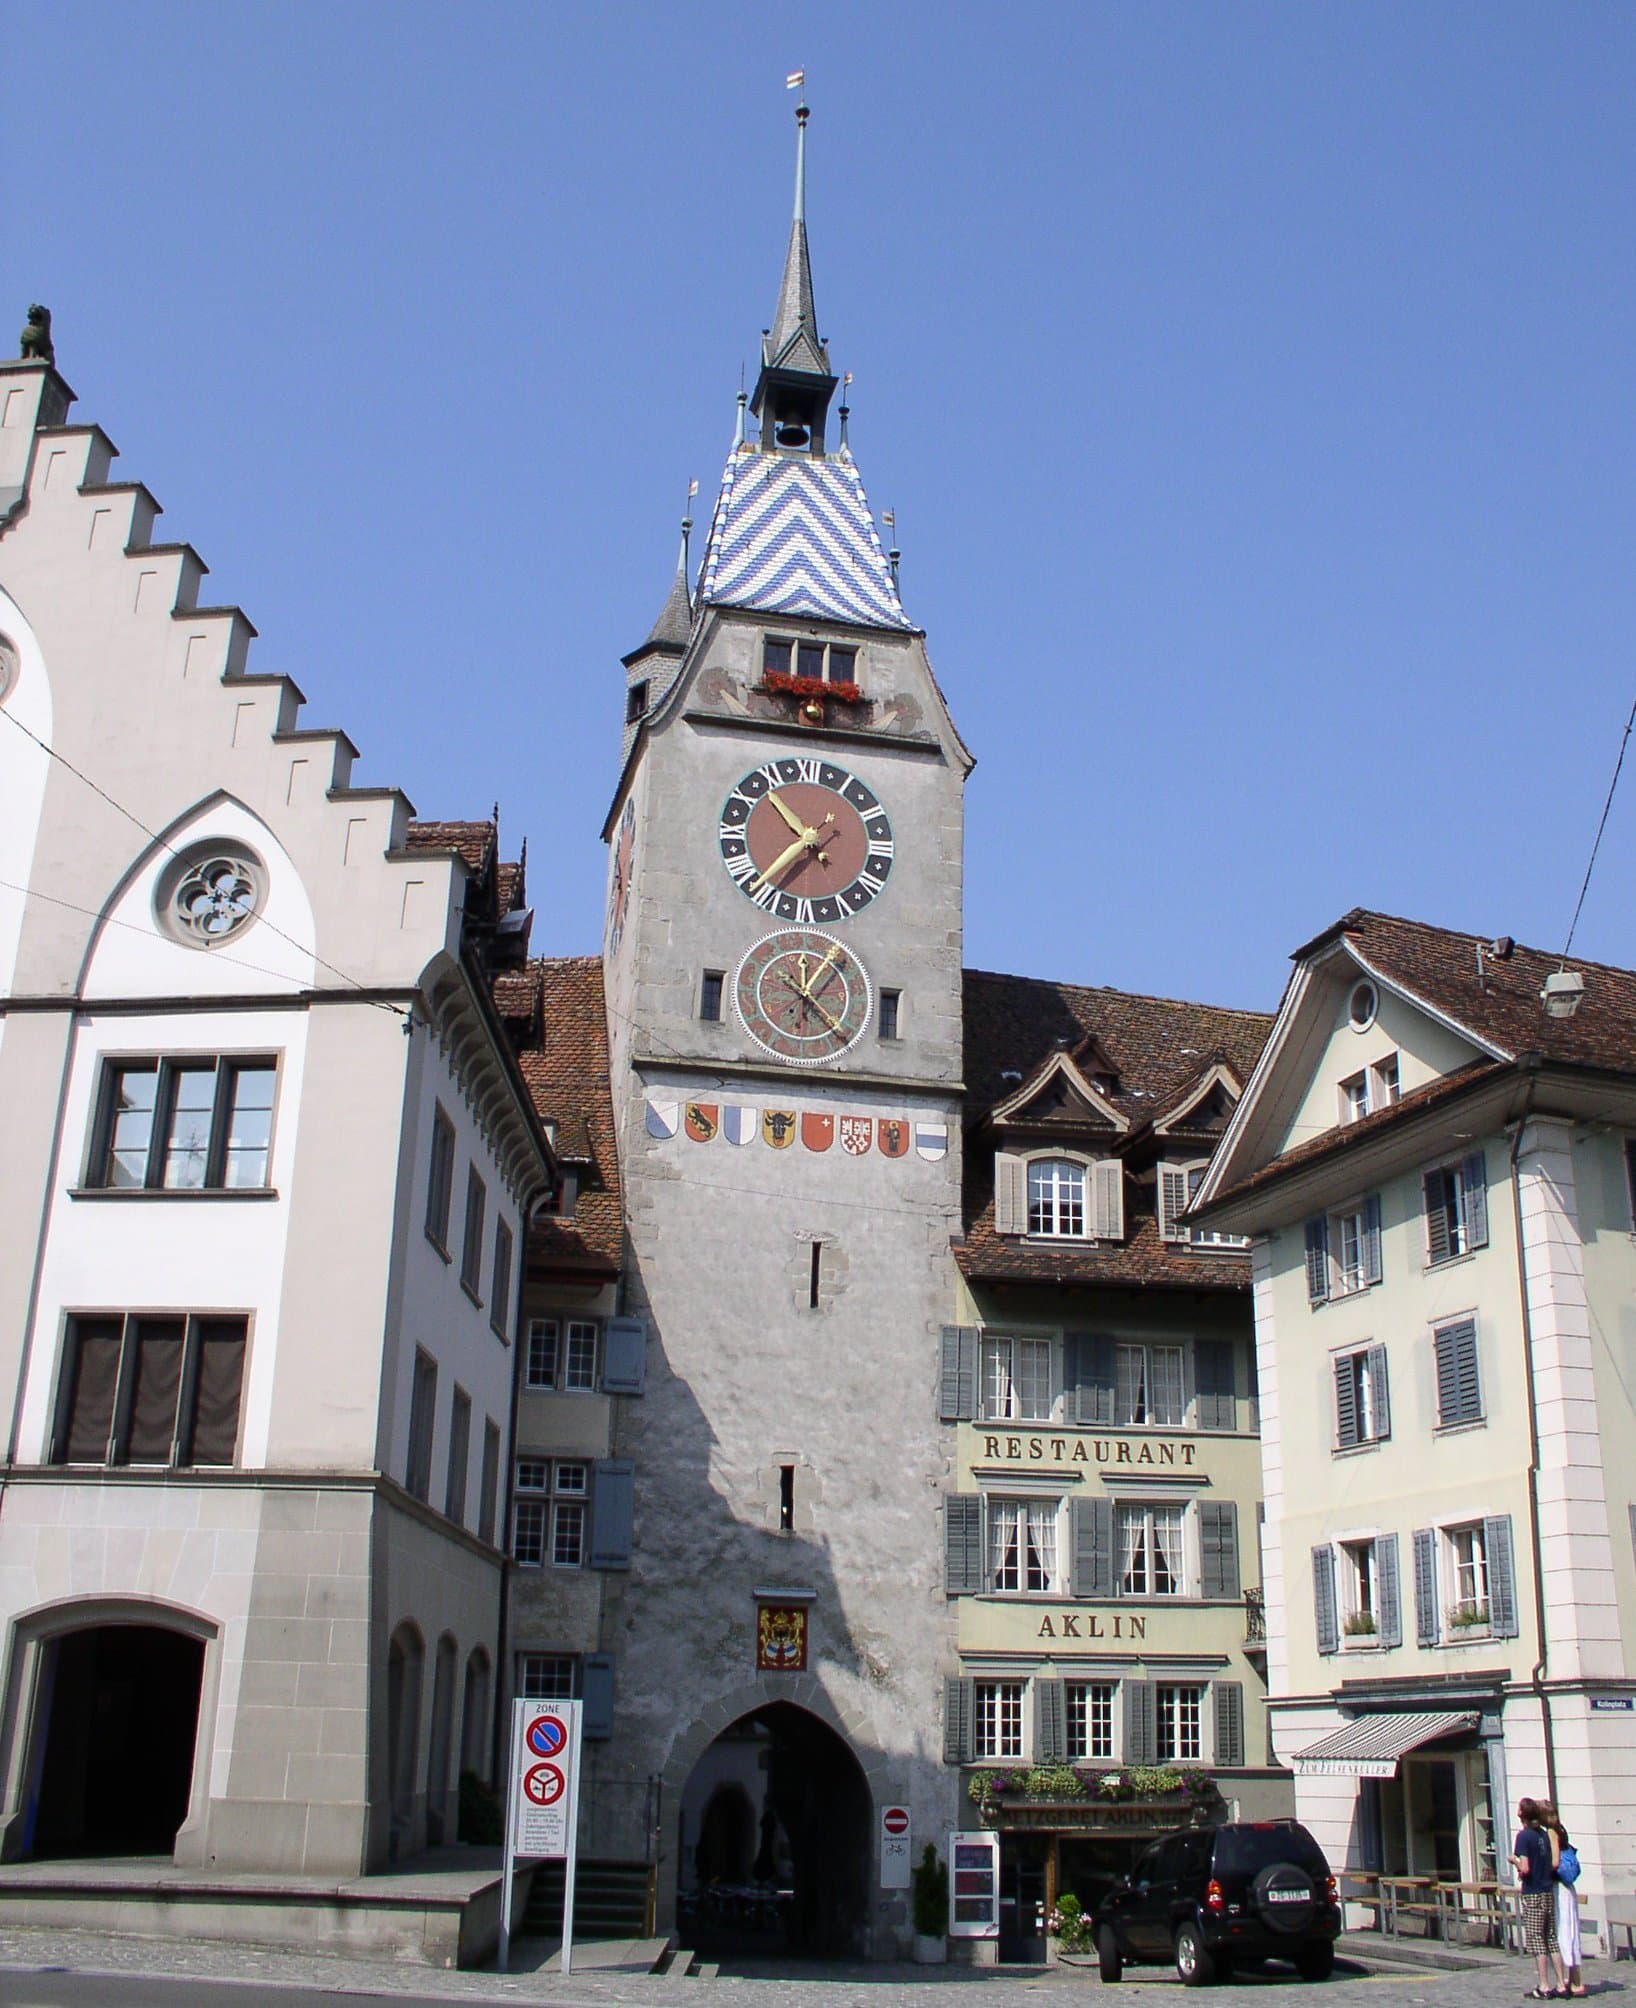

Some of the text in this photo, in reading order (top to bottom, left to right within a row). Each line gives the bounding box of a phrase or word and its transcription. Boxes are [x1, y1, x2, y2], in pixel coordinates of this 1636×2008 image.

[757, 762, 785, 789] XI
[796, 759, 822, 784] XII
[838, 774, 854, 794] I
[730, 787, 759, 809] X
[859, 804, 886, 822] II
[720, 821, 746, 840] IX
[869, 839, 894, 858] III
[858, 871, 886, 898] IV
[796, 898, 817, 924] VI
[835, 894, 855, 919] V
[983, 1436, 1197, 1466] RESTAURANT
[1037, 1614, 1148, 1640] AKLIN
[535, 1703, 561, 1714] ZONE
[1002, 1808, 1098, 1825] METZGEREI
